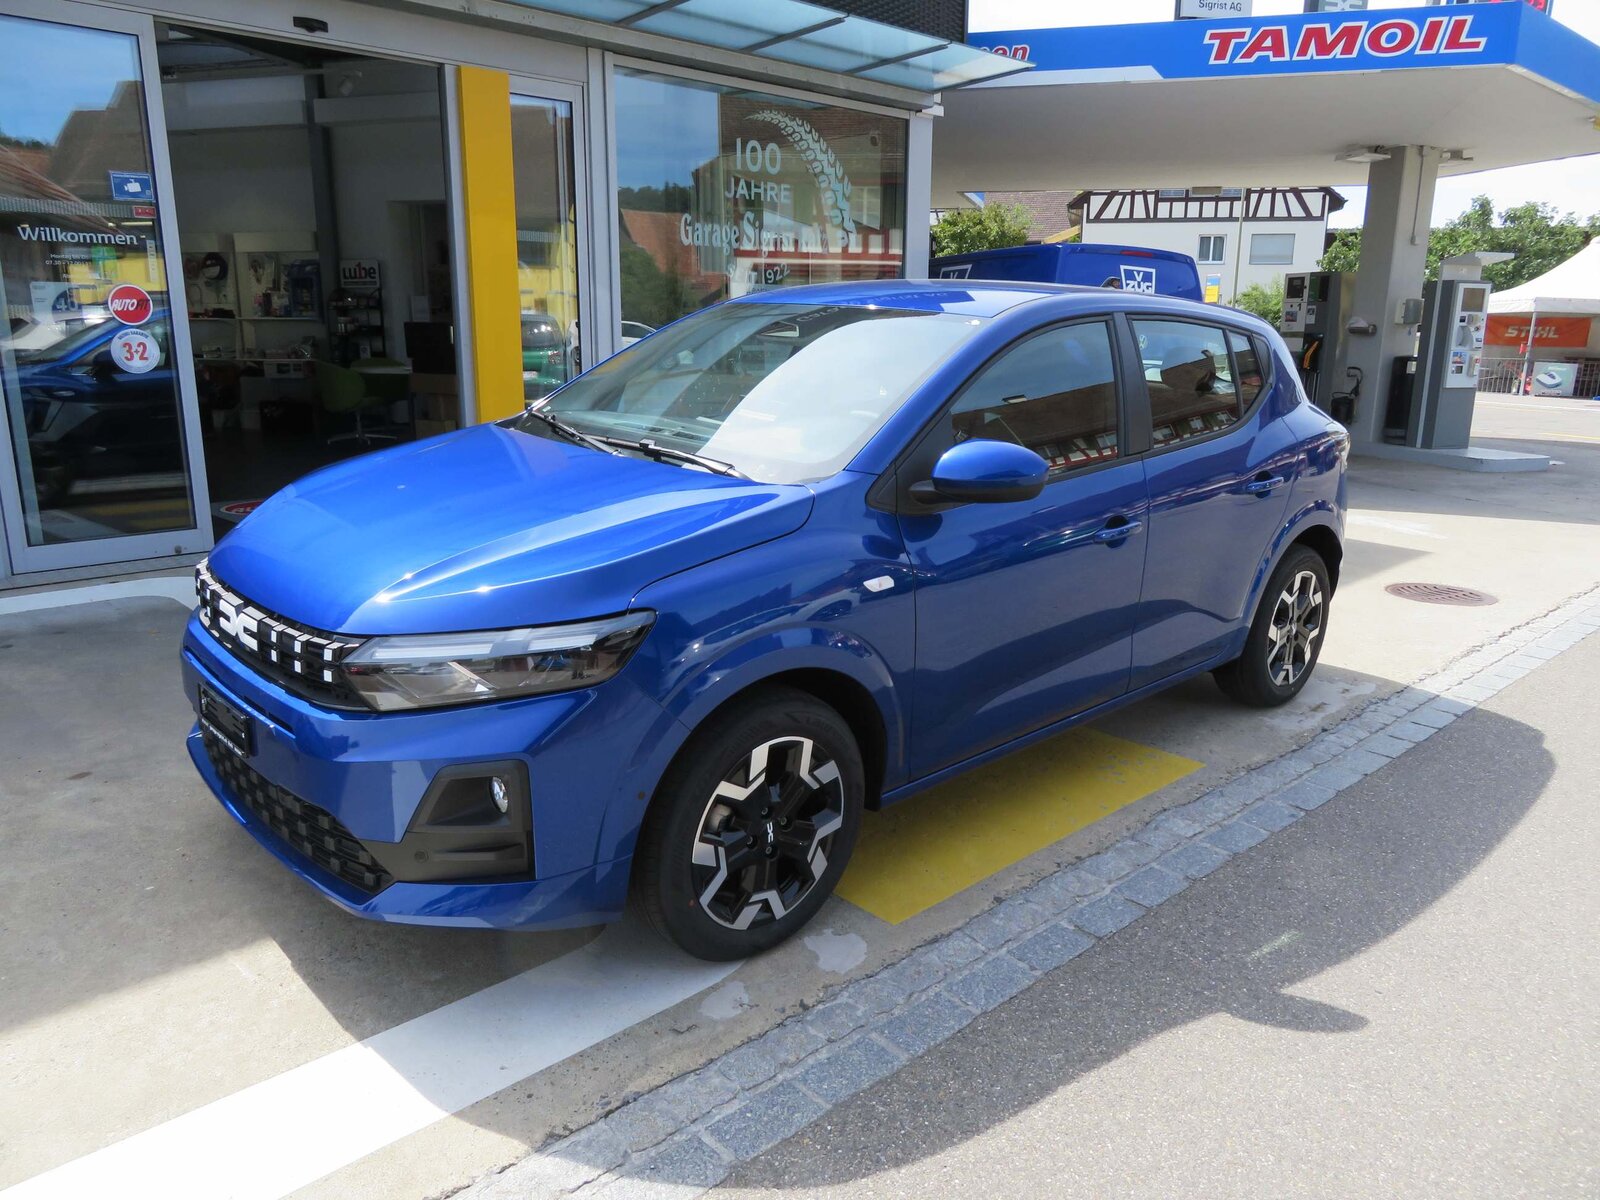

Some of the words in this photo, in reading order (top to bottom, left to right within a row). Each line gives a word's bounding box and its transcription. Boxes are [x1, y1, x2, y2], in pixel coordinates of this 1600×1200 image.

[1199, 0, 1227, 11] Sigrist
[1229, 2, 1242, 11] AG
[1202, 15, 1488, 65] TAMOIL
[736, 137, 781, 175] 100
[725, 177, 791, 203] JAHRE
[17, 226, 138, 245] Willkommen
[681, 212, 740, 256] Garage
[1133, 270, 1144, 282] V
[1126, 280, 1152, 293] ZUG
[1504, 326, 1559, 338] STHL
